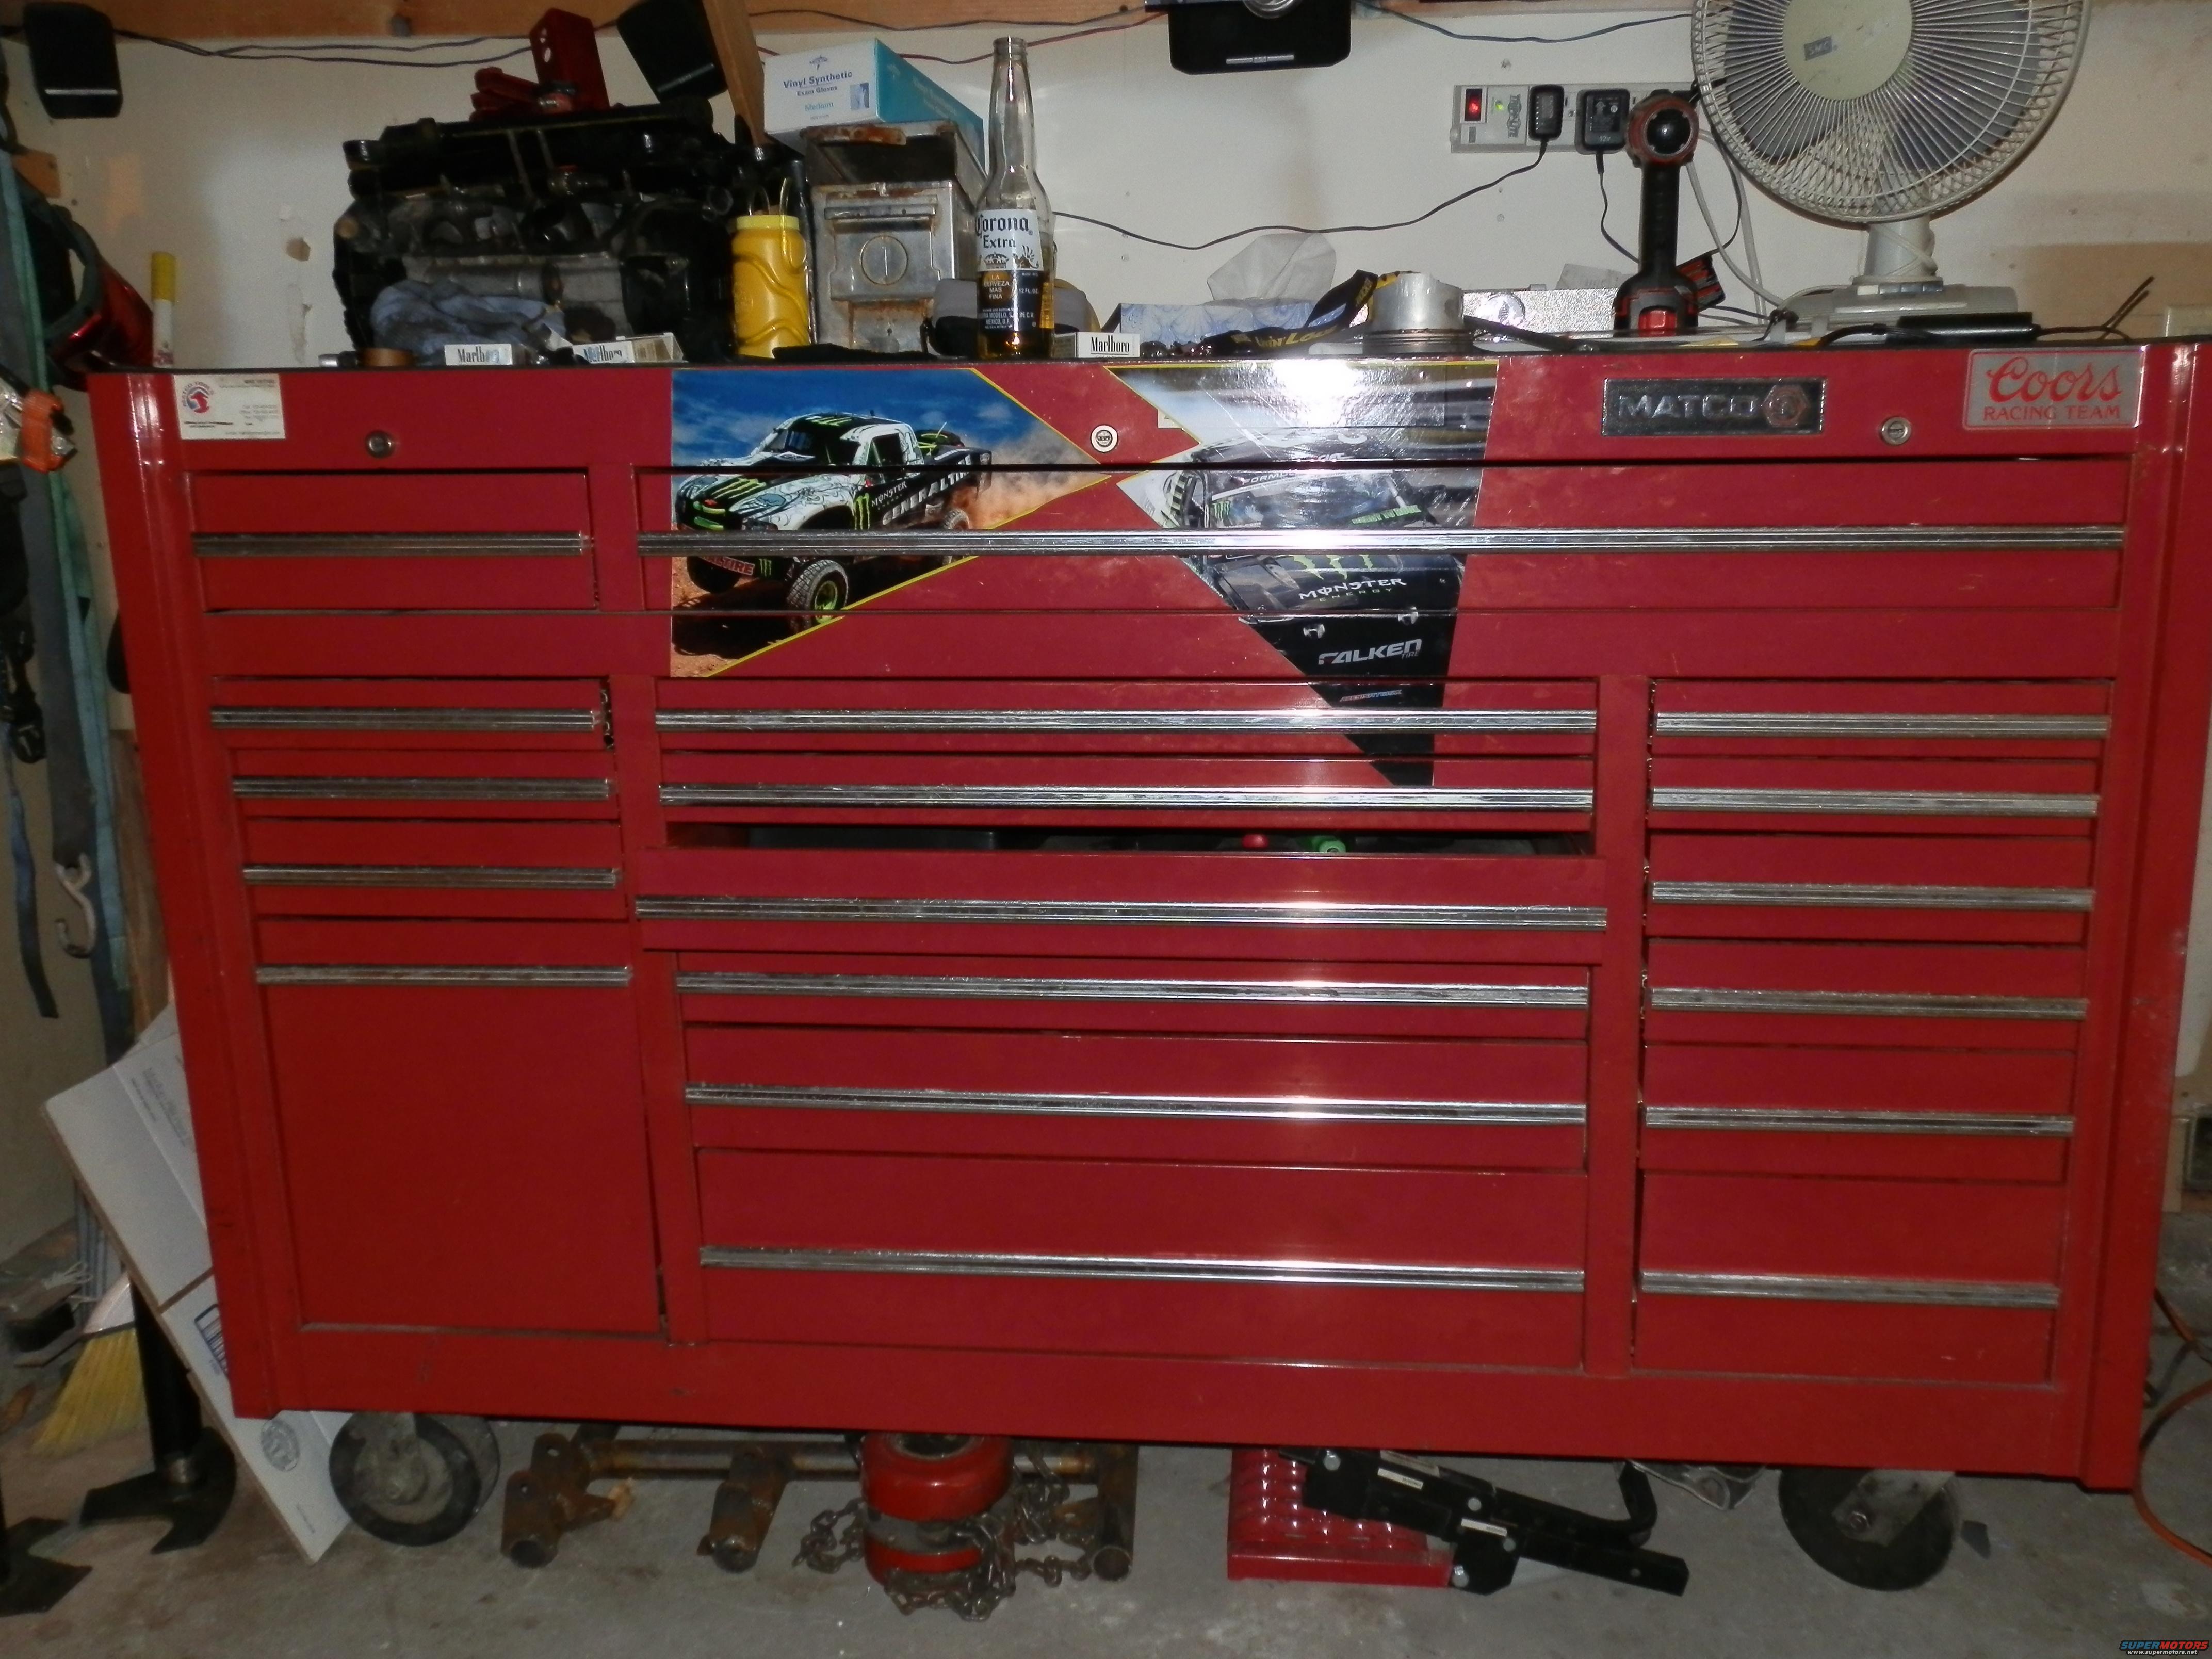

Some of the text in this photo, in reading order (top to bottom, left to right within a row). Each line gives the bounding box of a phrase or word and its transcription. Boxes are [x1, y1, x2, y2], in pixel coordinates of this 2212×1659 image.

[783, 71, 853, 88] Vinyl Synthetic
[816, 85, 838, 94] Gloves
[975, 213, 1030, 238] Corona
[983, 235, 1016, 249] Extra
[1091, 335, 1130, 353] Marlboro
[458, 346, 500, 363] Marlb
[583, 345, 623, 362] Mlboro
[1987, 356, 2122, 403] Coors
[1618, 394, 1760, 418] MATCO
[1983, 405, 2121, 421] RACING TEAM
[871, 480, 907, 507] MONSTER
[1298, 578, 1407, 600] MONSTER
[1319, 588, 1392, 602] ENERGY
[1318, 638, 1422, 665] FALKEN
[1402, 650, 1419, 659] TIRE
